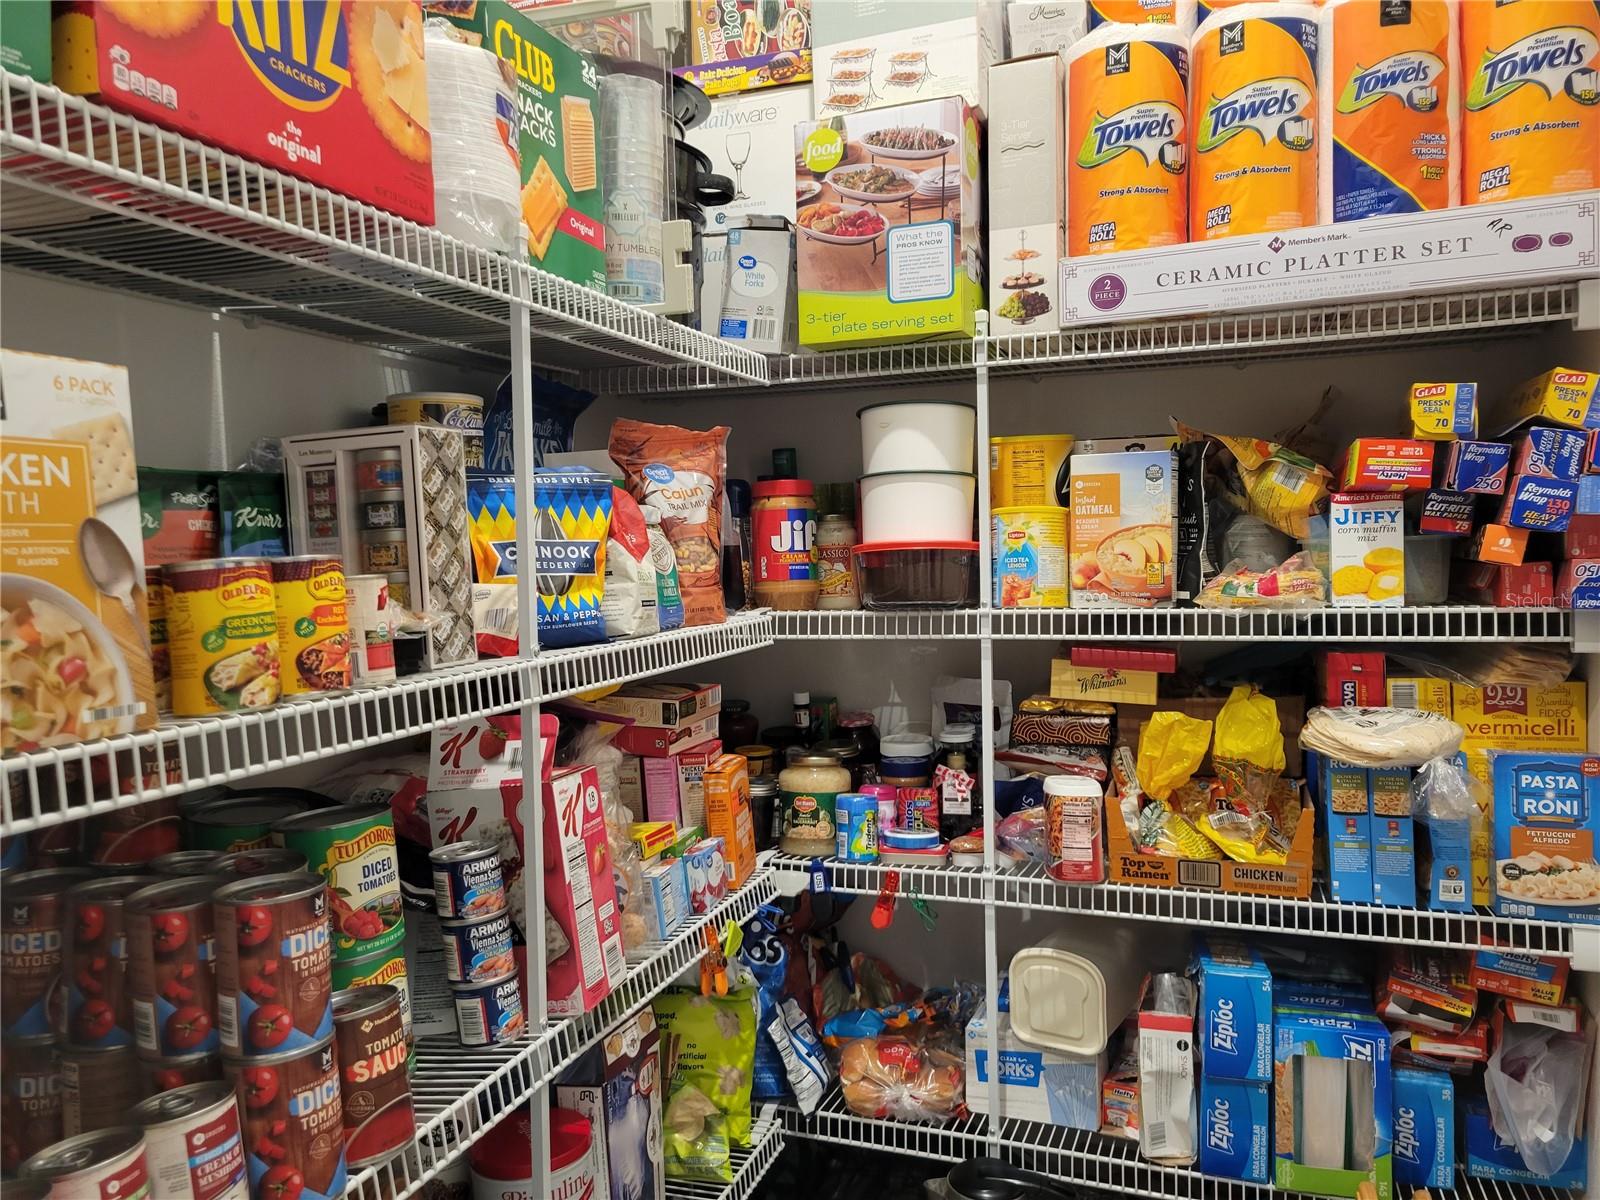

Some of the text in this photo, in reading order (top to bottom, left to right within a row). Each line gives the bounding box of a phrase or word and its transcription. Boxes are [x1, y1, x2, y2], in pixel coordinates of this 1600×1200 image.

[1526, 39, 1564, 51] Premium
[1534, 35, 1559, 45] Super
[495, 19, 556, 93] CLUB
[581, 61, 596, 81] 24
[1387, 61, 1415, 70] Premium
[1484, 39, 1586, 94] Towels
[269, 57, 327, 94] CRACKERS
[1353, 62, 1429, 101] Towels
[1210, 89, 1298, 137] Towels
[286, 121, 302, 137] the
[1094, 112, 1175, 156] Towels
[1490, 127, 1520, 141] Strong
[1533, 121, 1580, 132] Absorbent
[267, 131, 322, 165] original
[806, 138, 843, 158] food
[1411, 147, 1441, 155] STRONG
[1214, 172, 1240, 181] Strong
[1250, 165, 1291, 174] Absorbent
[1421, 166, 1428, 179] 1
[1481, 166, 1509, 179] MEGA
[1479, 175, 1509, 192] ROLL
[1100, 188, 1125, 198] Strong
[1134, 186, 1169, 195] Absorbent
[1207, 206, 1231, 217] MEGA
[570, 216, 595, 238] Original
[1207, 215, 1231, 228] ROLL
[1091, 223, 1116, 234] MEGA
[896, 230, 943, 242] What the
[1090, 231, 1116, 242] ROLL
[1288, 236, 1326, 247] Member's
[919, 239, 943, 247] KNOW
[1156, 236, 1473, 288] CERAMIC PLATTER SET
[744, 272, 766, 281] White
[744, 280, 764, 288] Forks
[1104, 280, 1111, 290] 2
[1095, 291, 1120, 300] PIECE
[805, 311, 847, 325] 3-tier
[832, 312, 955, 337] plate serving set
[1554, 373, 1586, 383] GLAD
[53, 375, 115, 397] 6 PACK
[1416, 385, 1446, 398] GLAD
[1557, 394, 1579, 404] SEAL
[1423, 405, 1445, 414] SEAL
[1567, 408, 1581, 419] 70
[1434, 418, 1449, 428] 70
[1414, 447, 1424, 456] 12
[1467, 443, 1507, 456] Reynolds
[1561, 433, 1577, 458] Wrap
[1464, 453, 1485, 463] Wrap
[1528, 450, 1545, 474] 150
[1568, 437, 1586, 477] Reynolds
[562, 476, 590, 484] EVER
[1379, 471, 1406, 479] Hefty
[1475, 476, 1502, 490] 250
[661, 486, 704, 501] Cajun
[1523, 482, 1573, 498] Reynolds
[170, 491, 198, 505] Pasta
[1333, 492, 1401, 503] America's Favorite
[1428, 492, 1465, 503] Reynolds
[1518, 491, 1570, 509] Wrap 130
[668, 499, 708, 512] TRAIL MIX
[1075, 504, 1114, 515] OATMEAL
[1425, 501, 1474, 514] CUT-RITE
[235, 507, 284, 528] Knorr
[1334, 508, 1401, 526] JIFFY
[1442, 512, 1468, 520] PAPER
[1523, 510, 1560, 522] HEAVY
[1523, 518, 1551, 526] DUTY
[1337, 524, 1397, 535] corn muffin
[1456, 521, 1469, 531] 75
[770, 519, 817, 553] Jif
[1356, 532, 1378, 542] mix
[313, 580, 329, 590] OLD
[222, 587, 243, 601] OLD
[226, 617, 254, 628] GREEN
[563, 612, 570, 621] &
[583, 619, 598, 627] SEEDS
[1077, 672, 1127, 694] Whitman's
[1539, 709, 1572, 718] FIDEO
[1466, 718, 1575, 736] vermicelli
[440, 725, 480, 769] K
[444, 768, 487, 776] STRAWBERRY
[1521, 775, 1579, 790] PASTA
[588, 791, 596, 803] 18
[562, 782, 582, 838] K
[1523, 799, 1578, 815] RONI
[1526, 830, 1577, 839] FETTUCCINE
[1532, 836, 1570, 845] ALFREDO
[362, 856, 392, 878] DICED
[1120, 857, 1146, 870] Top
[464, 869, 488, 888] Vienna
[1121, 867, 1169, 881] Ramen
[1234, 868, 1284, 882] CHICKEN
[358, 871, 397, 893] TOMATOES
[471, 933, 496, 952] Vienna
[1504, 952, 1537, 964] Hefty
[1499, 959, 1537, 972] FREEZER
[1263, 979, 1271, 992] 54
[1476, 978, 1486, 986] 25
[1530, 986, 1555, 997] VALUE
[1532, 993, 1553, 1001] PACK
[1443, 999, 1468, 1012] VALUE
[1213, 998, 1234, 1050] Ziploc
[1298, 1016, 1354, 1030] Ziploc
[366, 1028, 404, 1055] TOMATO
[1257, 1023, 1265, 1077] PARA CONGELAR
[1265, 1049, 1271, 1057] DE
[677, 1063, 705, 1071] flavors
[1113, 1088, 1135, 1099] Hefty
[1442, 1089, 1451, 1101] 38
[1209, 1098, 1230, 1150] Ziploc
[1395, 1107, 1415, 1159] Ziploc
[1253, 1125, 1261, 1162] CONGELAR
[1259, 1150, 1266, 1159] DE
[1437, 1117, 1445, 1186] PARA CONGELAR
[197, 1153, 230, 1176] CREAM
[1472, 1163, 1550, 1180] PARA CONGELAR
